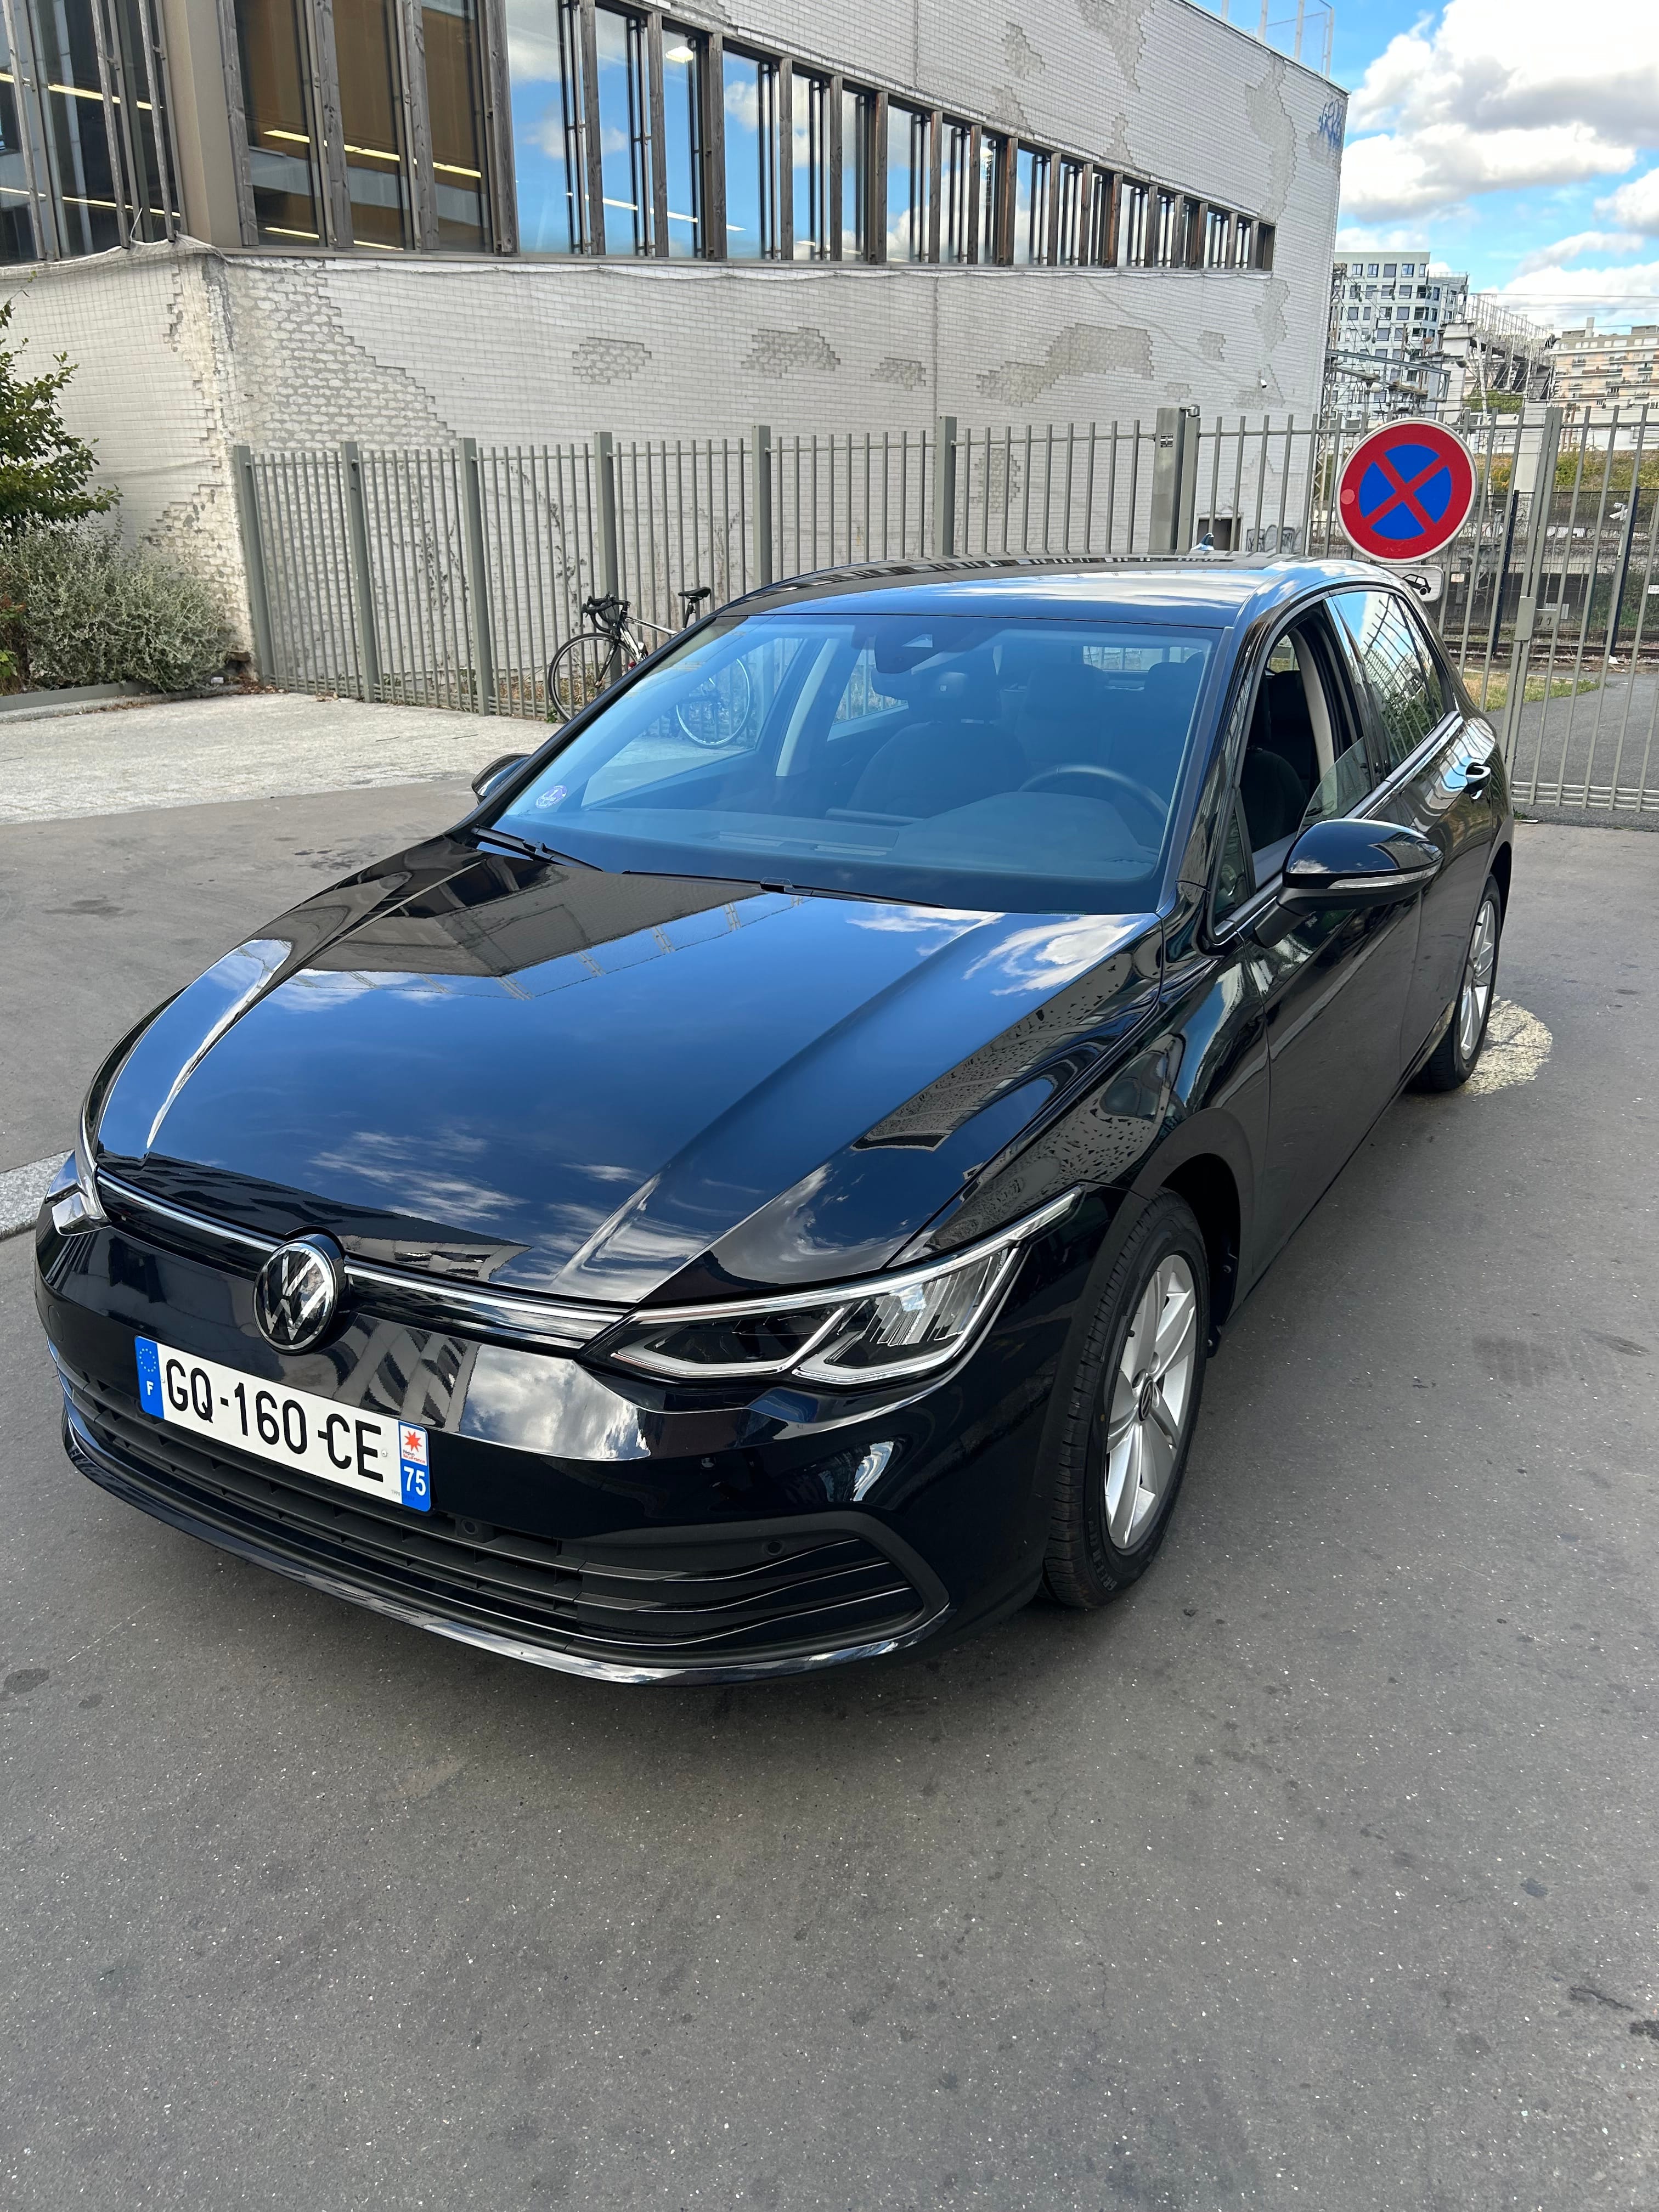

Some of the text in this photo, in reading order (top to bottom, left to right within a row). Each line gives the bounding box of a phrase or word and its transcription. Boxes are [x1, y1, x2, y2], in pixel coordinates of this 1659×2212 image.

[146, 1380, 154, 1396] F
[166, 1359, 383, 1482] GQ-160-CE
[404, 1466, 426, 1496] 75
